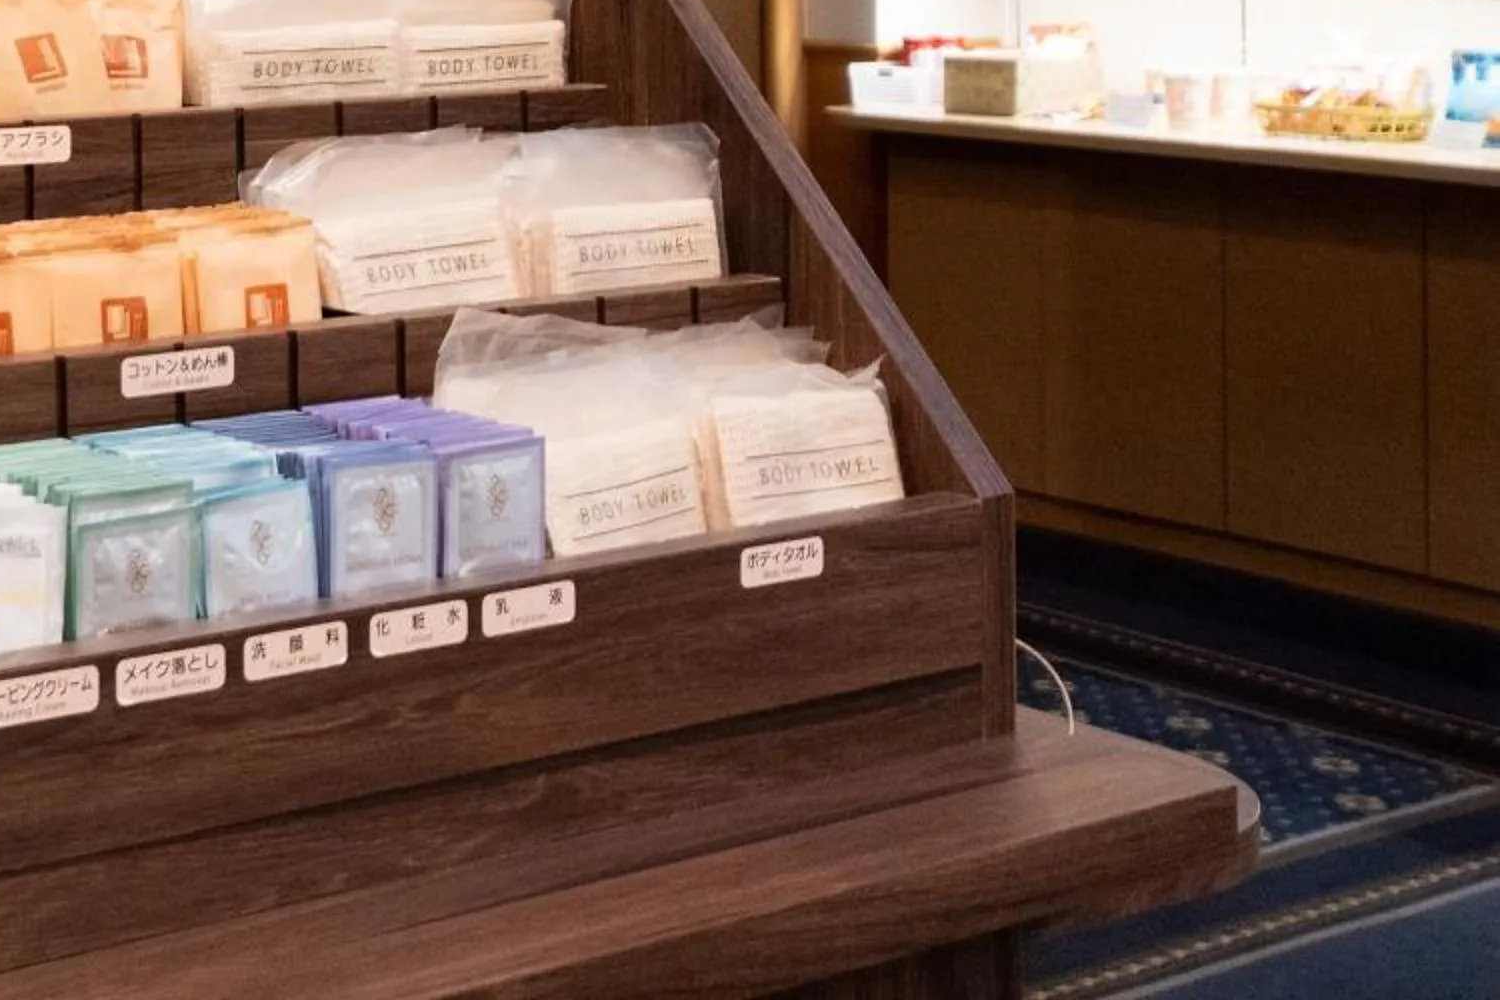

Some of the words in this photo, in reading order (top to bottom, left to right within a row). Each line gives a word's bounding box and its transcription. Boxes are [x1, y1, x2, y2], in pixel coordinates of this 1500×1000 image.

[253, 62, 303, 79] BODY
[312, 58, 376, 75] TOWEL
[427, 60, 475, 76] BODY
[483, 54, 540, 72] TOWEL
[366, 262, 418, 283] BODY
[428, 252, 488, 276] TOWEL
[578, 246, 627, 263] BODY
[760, 466, 802, 486] BODY
[809, 461, 880, 480] TOWEL
[578, 501, 625, 526] BODY
[635, 484, 688, 511] TOWEL
[747, 543, 819, 568] ボディタオル
[495, 587, 564, 617] 乳液
[375, 607, 462, 638] 化粧水
[123, 651, 219, 683] メイク落とし
